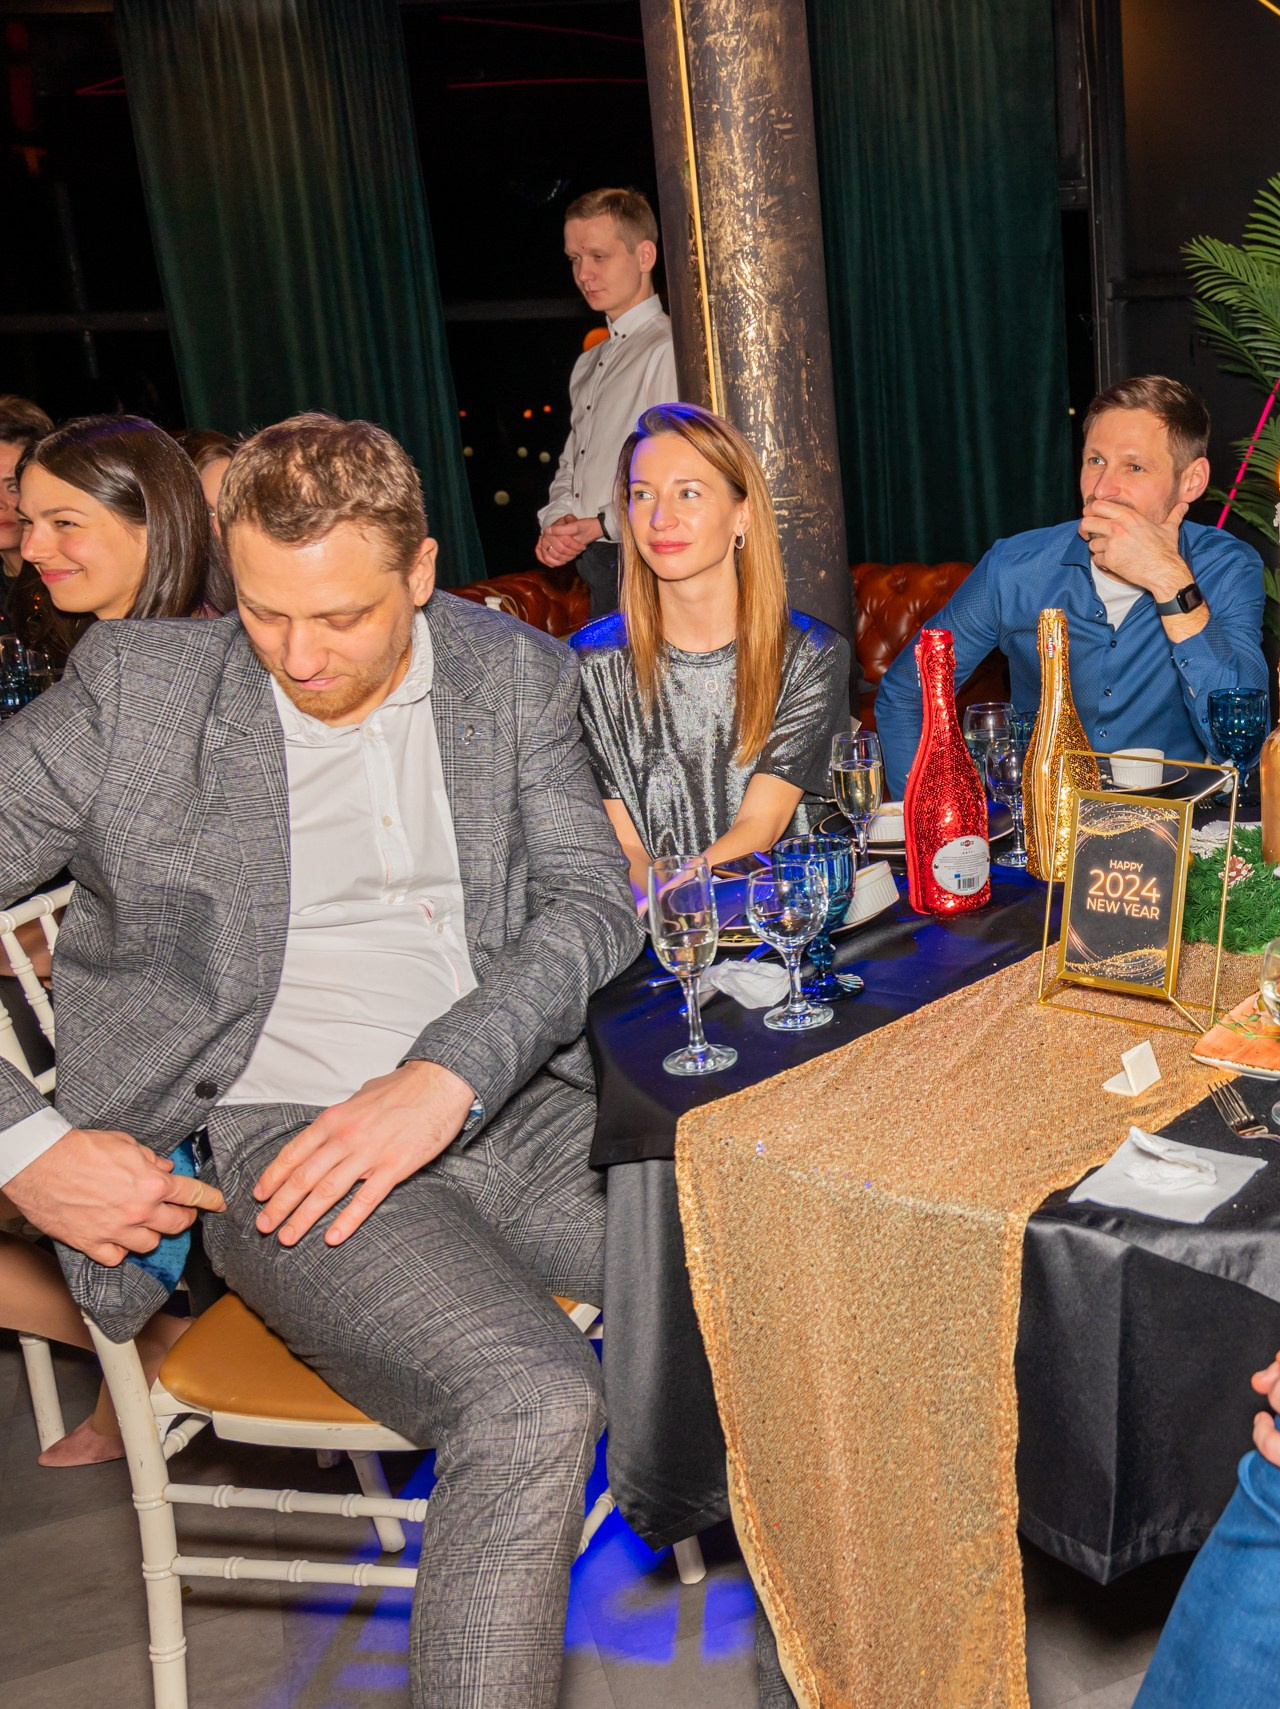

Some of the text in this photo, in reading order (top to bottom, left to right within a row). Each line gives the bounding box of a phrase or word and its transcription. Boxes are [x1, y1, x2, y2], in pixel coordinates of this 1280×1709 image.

[1109, 859, 1144, 873] HAPPY
[1088, 869, 1161, 904] 2024
[1086, 897, 1160, 920] NEW YEAR
